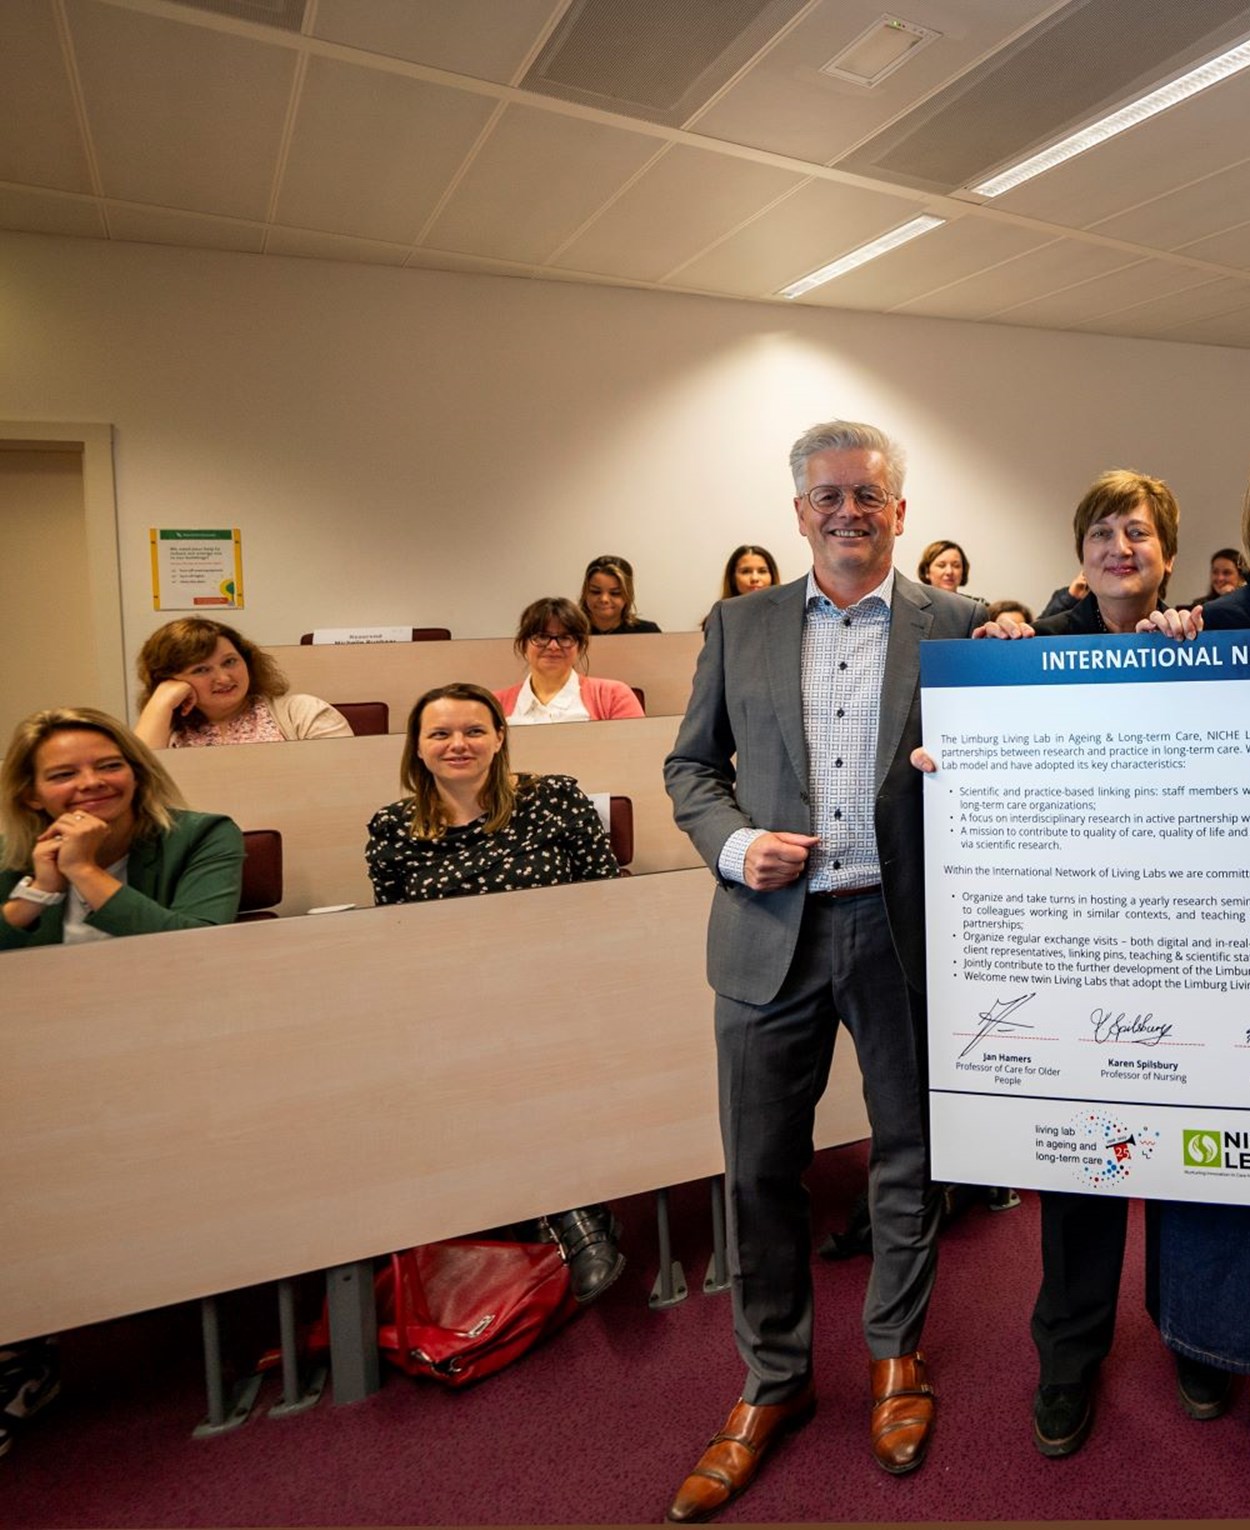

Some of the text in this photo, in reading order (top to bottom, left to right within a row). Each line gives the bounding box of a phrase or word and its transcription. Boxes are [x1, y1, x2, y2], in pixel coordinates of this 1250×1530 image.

[1041, 647, 1223, 671] INTERNATIONAL
[940, 734, 957, 744] The
[960, 733, 999, 746] Limburg
[1002, 734, 1029, 745] Living
[1033, 733, 1050, 742] Lab
[1055, 733, 1064, 742] in
[1068, 732, 1101, 744] Ageing
[1105, 732, 1113, 741] &
[1118, 731, 1170, 744] Long-term
[1175, 731, 1202, 742] Care,
[1206, 730, 1240, 740] NICHE
[941, 759, 1185, 772] Lab model and have adopted its key characteristics:
[959, 800, 1004, 812] long-term
[1028, 801, 1096, 812] organizations;
[959, 814, 967, 823] A
[968, 813, 993, 823] focus
[1009, 813, 1085, 825] interdisciplinary
[1088, 813, 1131, 823] research
[1133, 814, 1143, 823] in
[1145, 814, 1175, 823] active
[1177, 813, 1238, 825] partnership
[960, 839, 1062, 850] via scientific research.
[943, 865, 973, 875] Within
[974, 865, 990, 876] the
[992, 866, 1052, 877] International
[1055, 867, 1096, 877] Network
[1098, 868, 1108, 878] of
[1111, 869, 1140, 880] Living
[1142, 868, 1166, 878] Labs
[962, 918, 1024, 932] partnerships;
[963, 958, 992, 971] Jointly
[994, 959, 1043, 970] contribute
[1045, 962, 1055, 971] to
[1057, 961, 1073, 971] the
[1075, 962, 1110, 972] further
[1112, 963, 1180, 977] development
[1181, 965, 1192, 975] of
[1195, 965, 1212, 975] the
[982, 1052, 1031, 1063] Jan Hamers
[955, 1060, 1060, 1076] Professor of Care for Older
[1108, 1058, 1178, 1073] Karen Spilsbury
[994, 1075, 1022, 1087] People
[1100, 1068, 1186, 1084] Professor of Nursing
[1036, 1124, 1075, 1136] living lab
[1035, 1139, 1097, 1152] in ageing and
[1036, 1152, 1080, 1165] long-term
